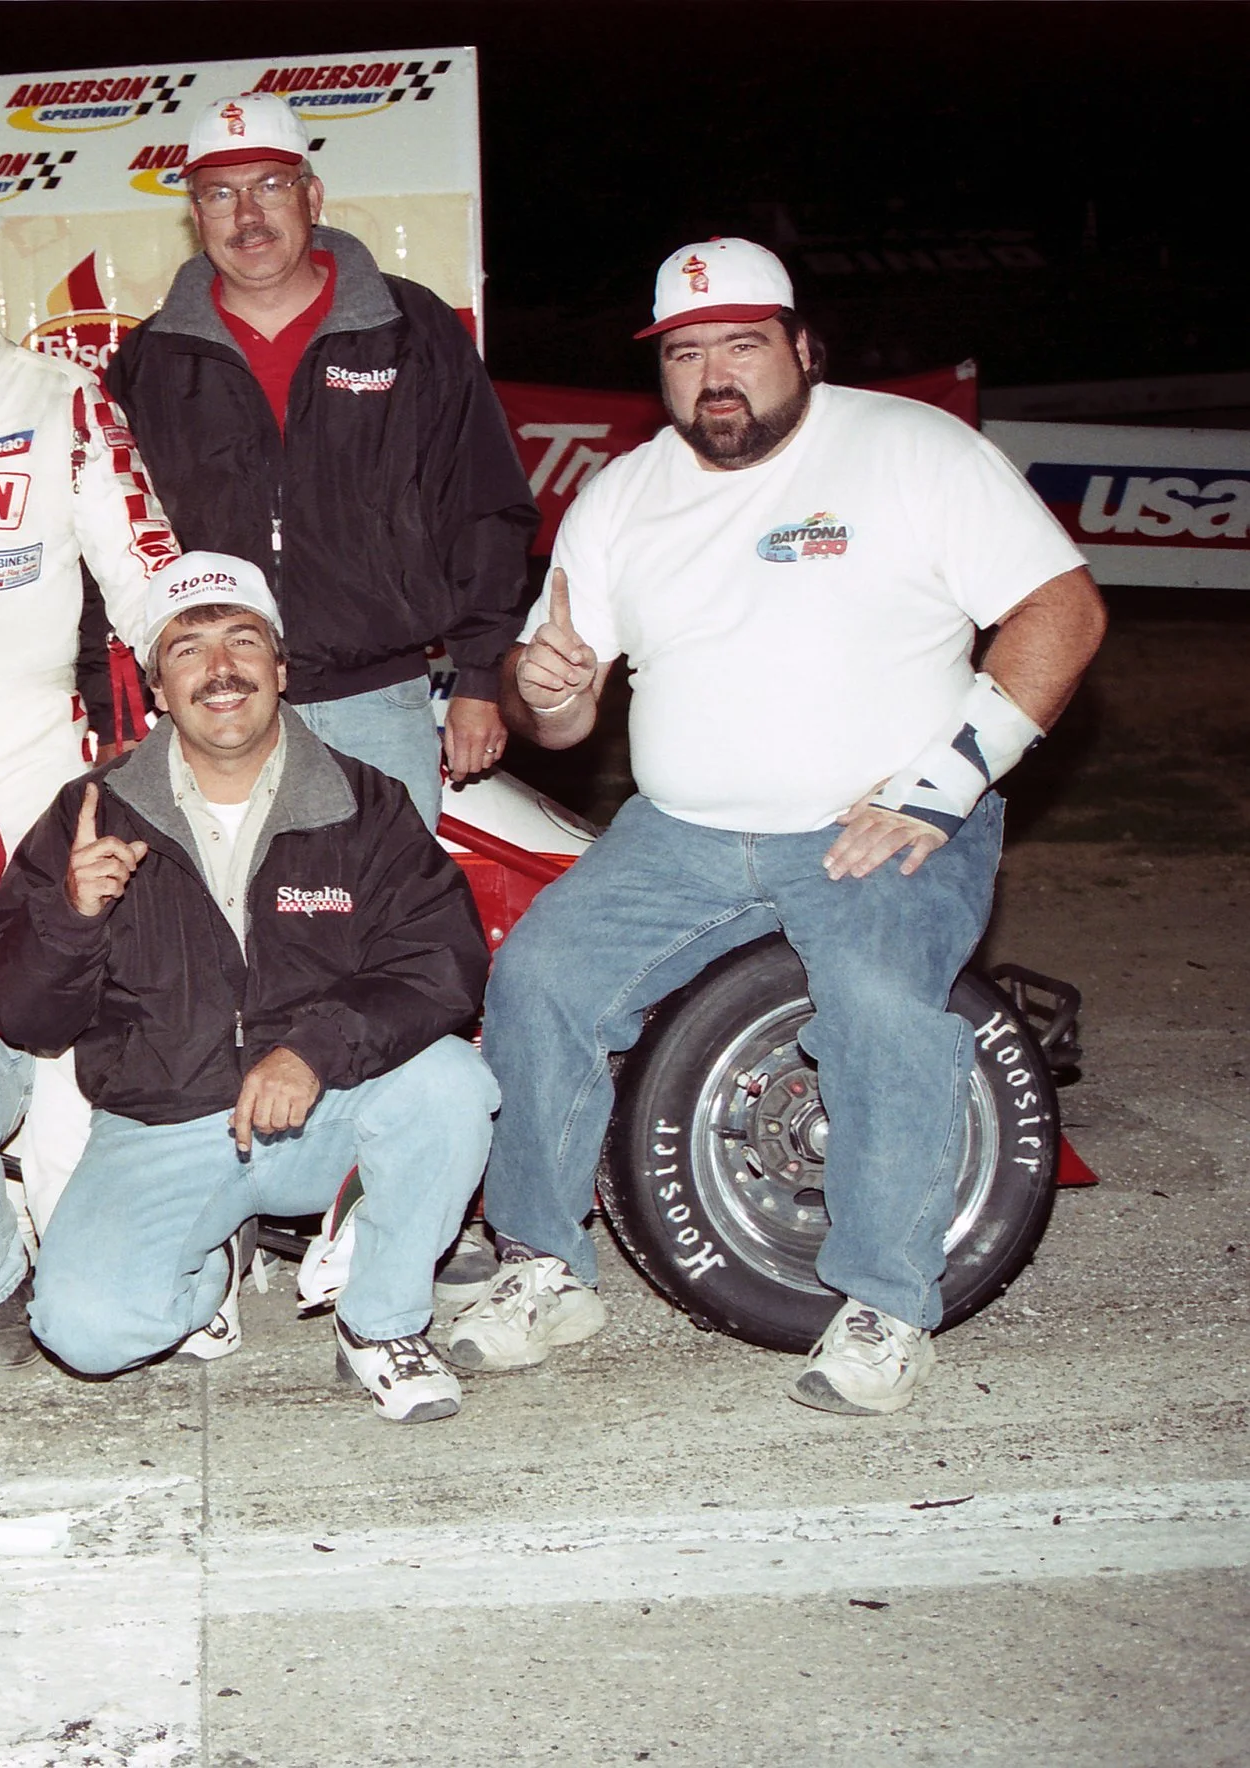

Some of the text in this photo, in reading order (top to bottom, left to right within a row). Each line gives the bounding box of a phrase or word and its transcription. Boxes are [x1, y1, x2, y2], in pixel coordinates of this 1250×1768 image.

[252, 63, 403, 93] ANDERSON
[5, 75, 151, 108] ANDERSON
[288, 92, 385, 107] SPEEDWAY
[38, 103, 134, 121] SPEEDWAY
[326, 366, 397, 384] Stealth
[1079, 475, 1250, 539] usa
[770, 526, 848, 545] DAYTONA
[801, 540, 847, 556] 500
[168, 573, 237, 599] Stoops
[277, 886, 353, 903] Stealth
[975, 1011, 1051, 1174] Hoosier
[645, 1118, 728, 1280] Hoosier
